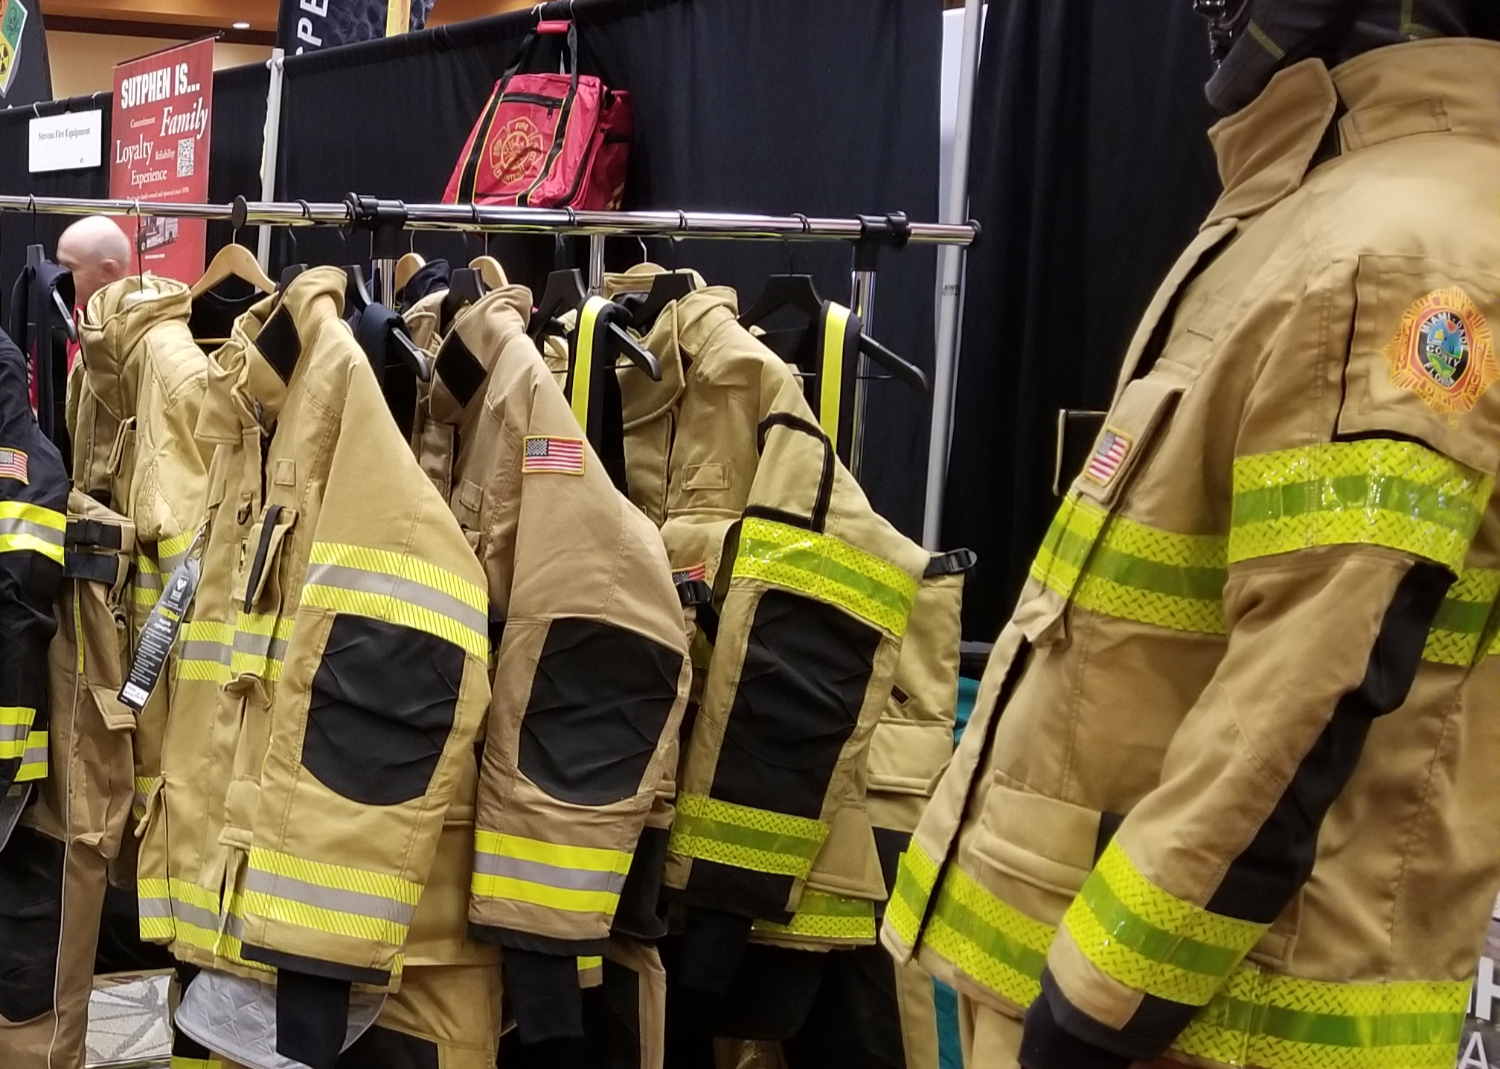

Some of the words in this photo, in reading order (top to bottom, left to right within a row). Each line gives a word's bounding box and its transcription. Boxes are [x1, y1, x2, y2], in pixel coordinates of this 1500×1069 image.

[121, 67, 171, 109] SUTPHEN
[174, 63, 201, 96] IS...
[160, 97, 208, 140] Family
[116, 133, 154, 169] Loyalty
[131, 168, 168, 189] Experience
